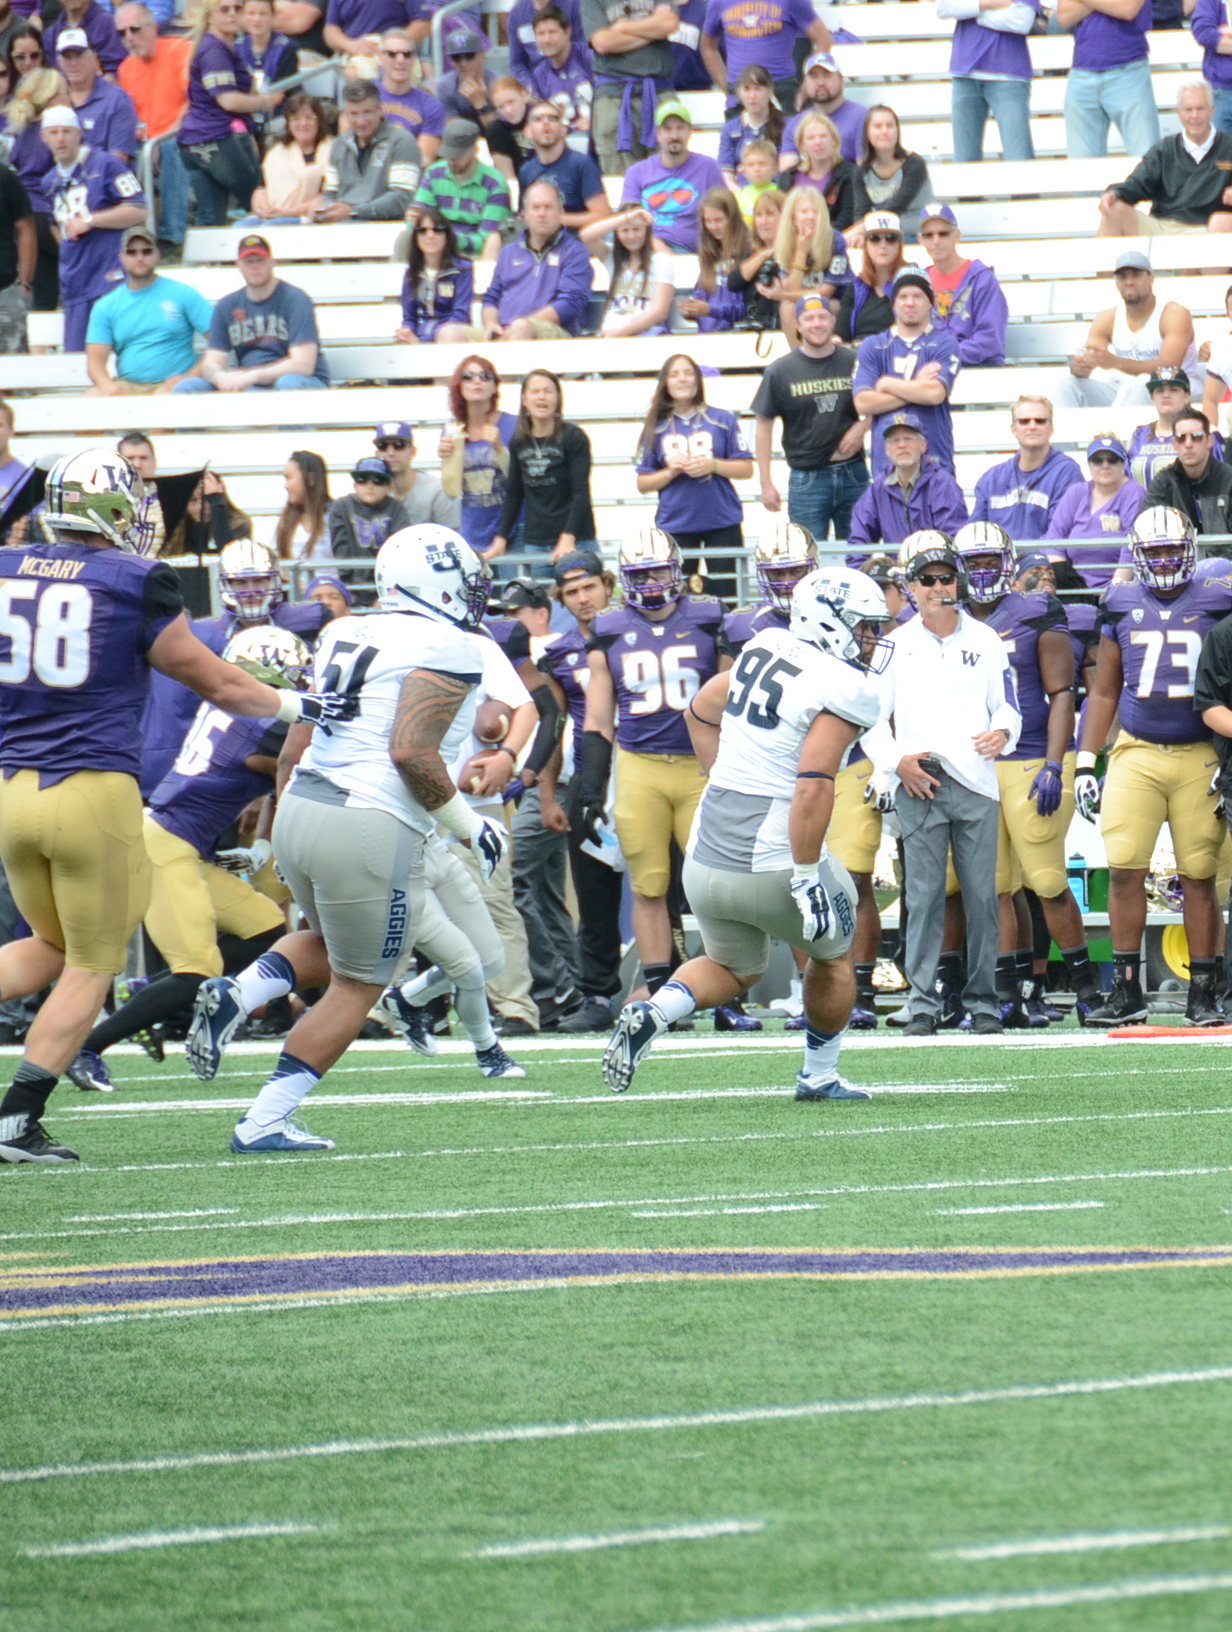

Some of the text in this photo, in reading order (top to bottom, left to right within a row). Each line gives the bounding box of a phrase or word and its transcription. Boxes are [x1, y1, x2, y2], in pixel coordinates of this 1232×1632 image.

[877, 218, 890, 228] W
[228, 312, 289, 347] BEARS
[894, 353, 918, 382] 7
[790, 377, 853, 397] HUSKIES
[814, 393, 838, 414] W
[102, 464, 139, 492] W
[464, 469, 496, 496] W
[351, 516, 392, 548] W
[1100, 513, 1121, 532] W
[17, 555, 87, 580] MCGARY
[924, 550, 945, 562] W
[812, 583, 852, 599] STATE
[1159, 611, 1172, 621] W
[652, 627, 665, 636] W
[961, 650, 982, 667] W
[1130, 630, 1203, 699] 73
[622, 644, 701, 715] 96
[722, 647, 804, 730] 95
[381, 888, 407, 959] AGGIES
[833, 891, 855, 937] AGGIES
